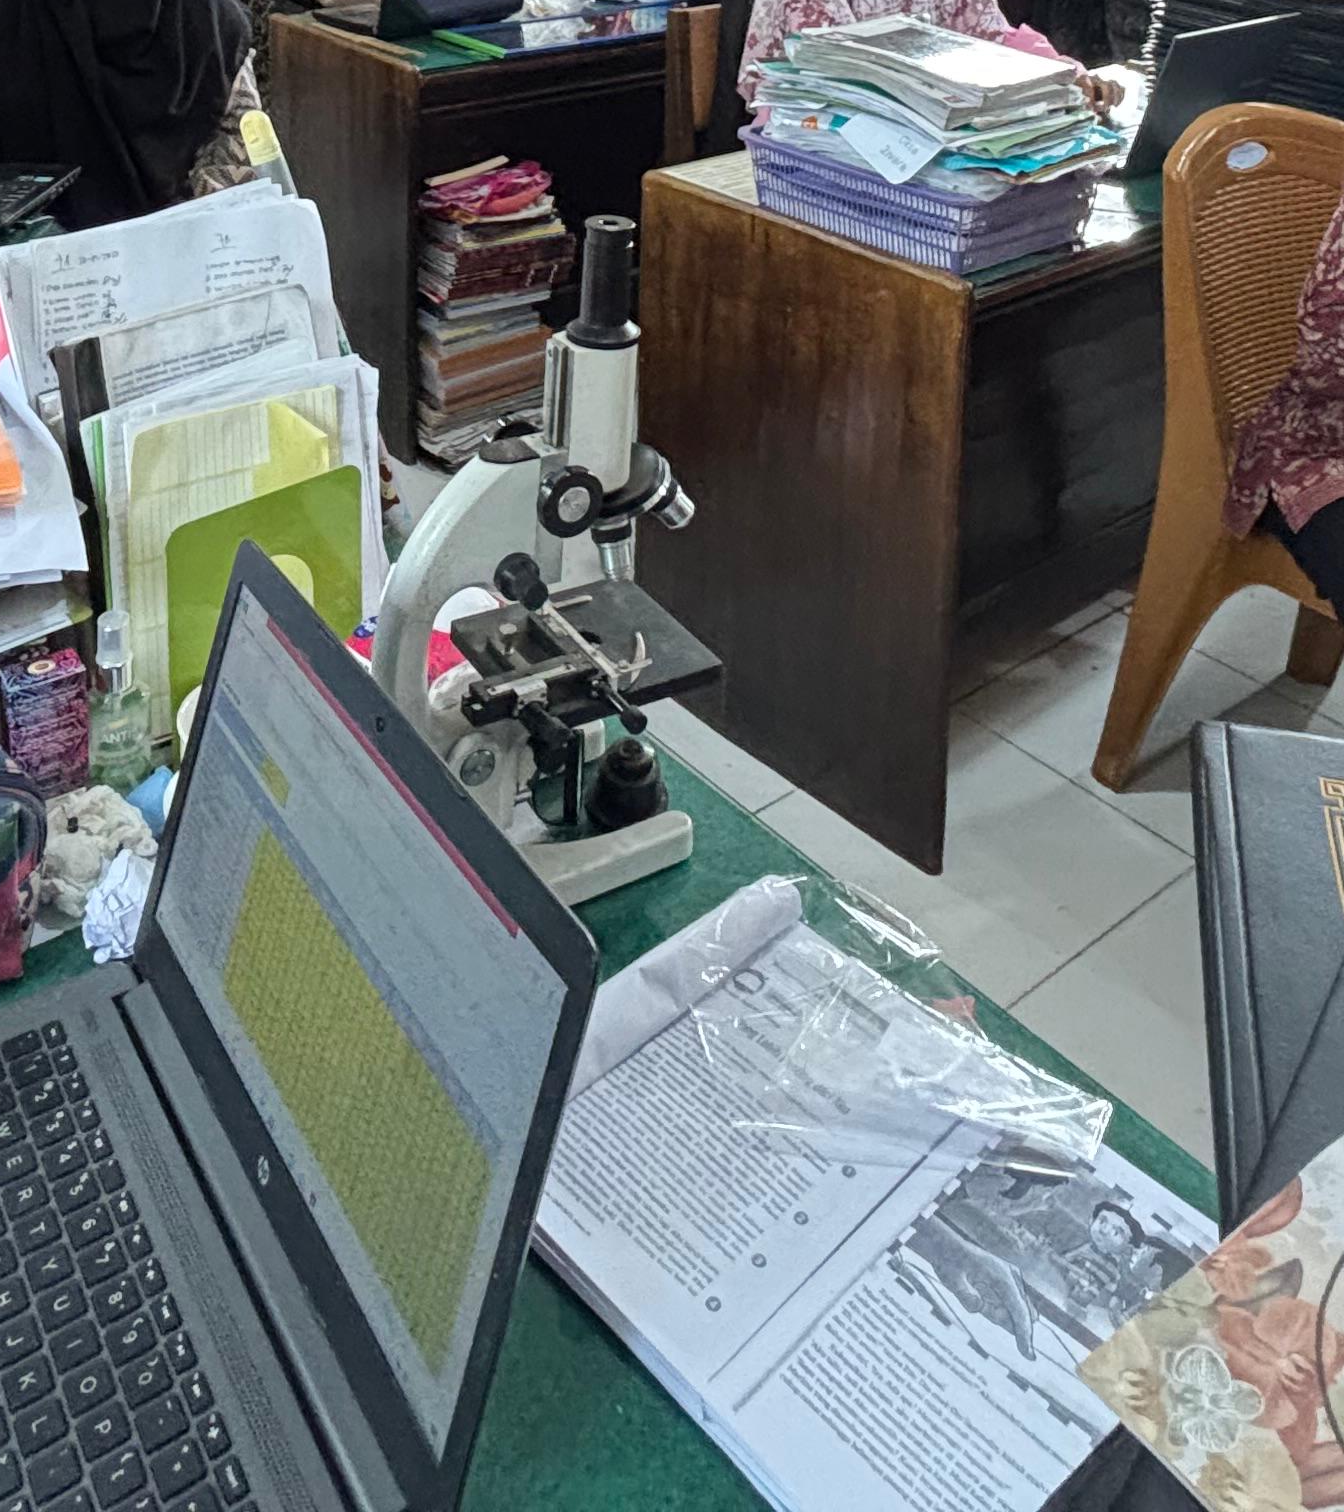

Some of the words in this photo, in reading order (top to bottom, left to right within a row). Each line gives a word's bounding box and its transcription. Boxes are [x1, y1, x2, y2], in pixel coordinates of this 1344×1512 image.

[5, 1336, 25, 1347] J
[18, 1371, 37, 1391] K
[31, 1415, 48, 1434] L
[6, 1154, 23, 1169] E
[17, 1186, 33, 1203] R
[29, 1221, 46, 1235] T
[41, 1256, 59, 1271] Y
[53, 1295, 71, 1312] U
[79, 1375, 98, 1394] O
[94, 1418, 112, 1434] P
